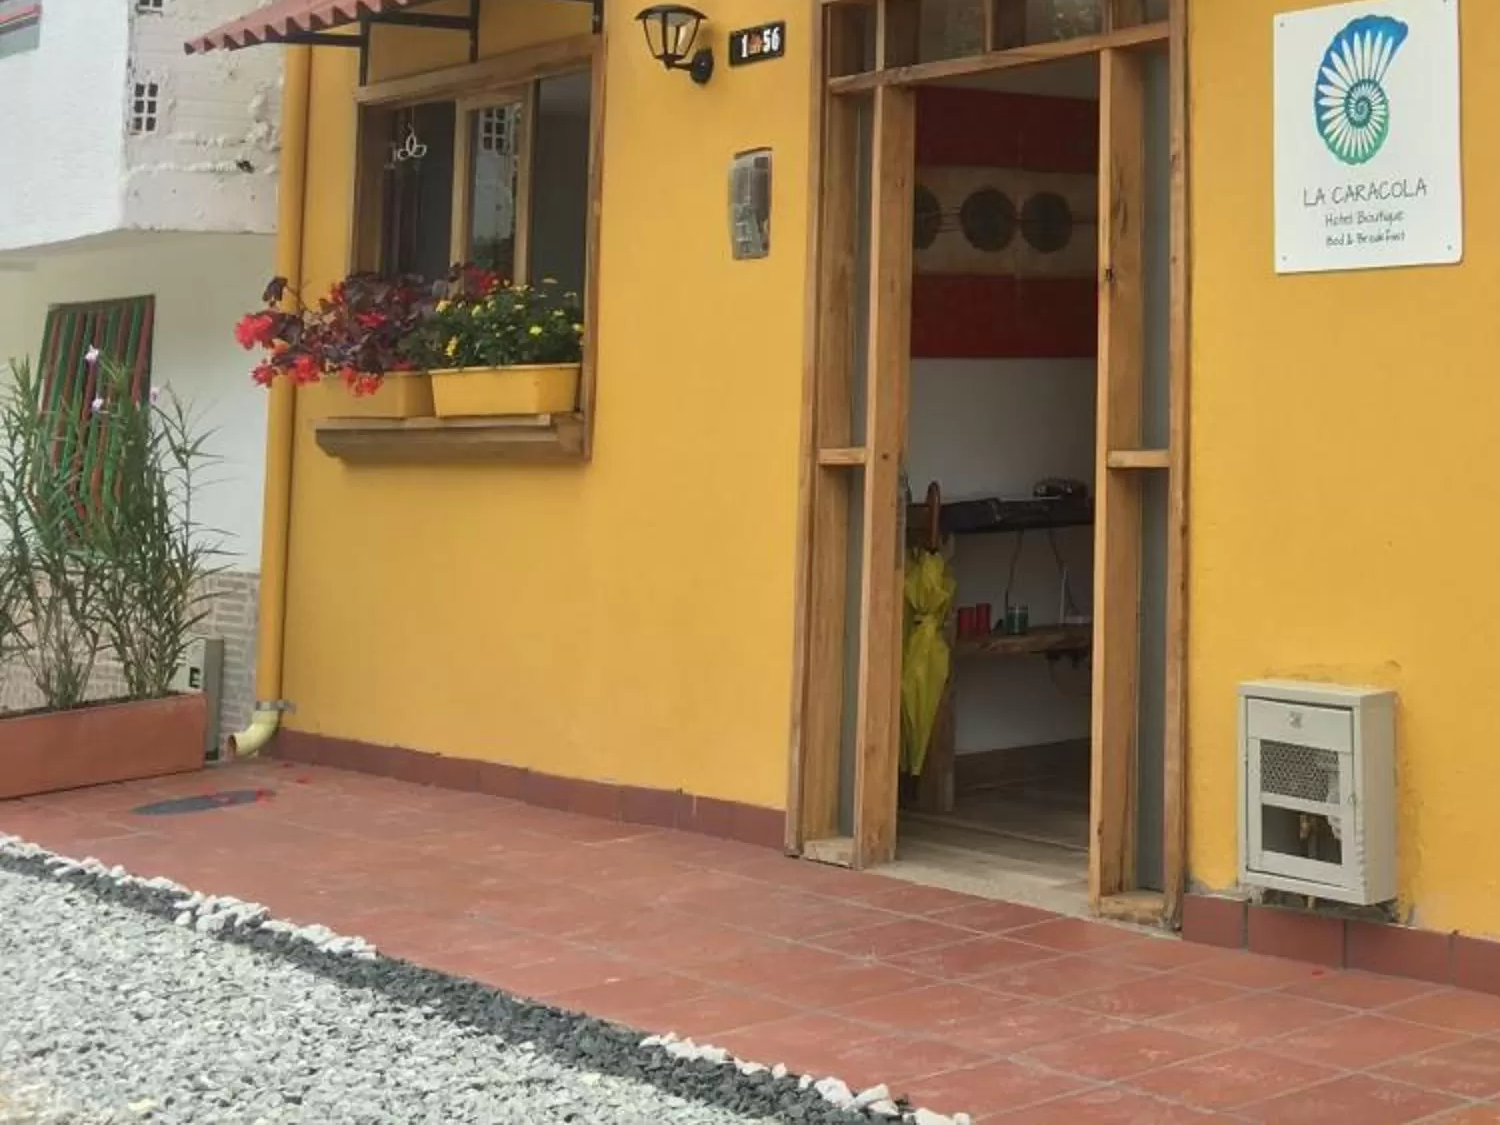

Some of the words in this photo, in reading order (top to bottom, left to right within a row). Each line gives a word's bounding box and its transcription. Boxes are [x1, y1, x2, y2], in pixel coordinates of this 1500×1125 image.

[763, 27, 780, 52] 56
[1303, 187, 1326, 207] LA
[1331, 177, 1427, 204] CARACOLA
[1325, 212, 1353, 228] Hotel
[1356, 210, 1405, 228] Boutique
